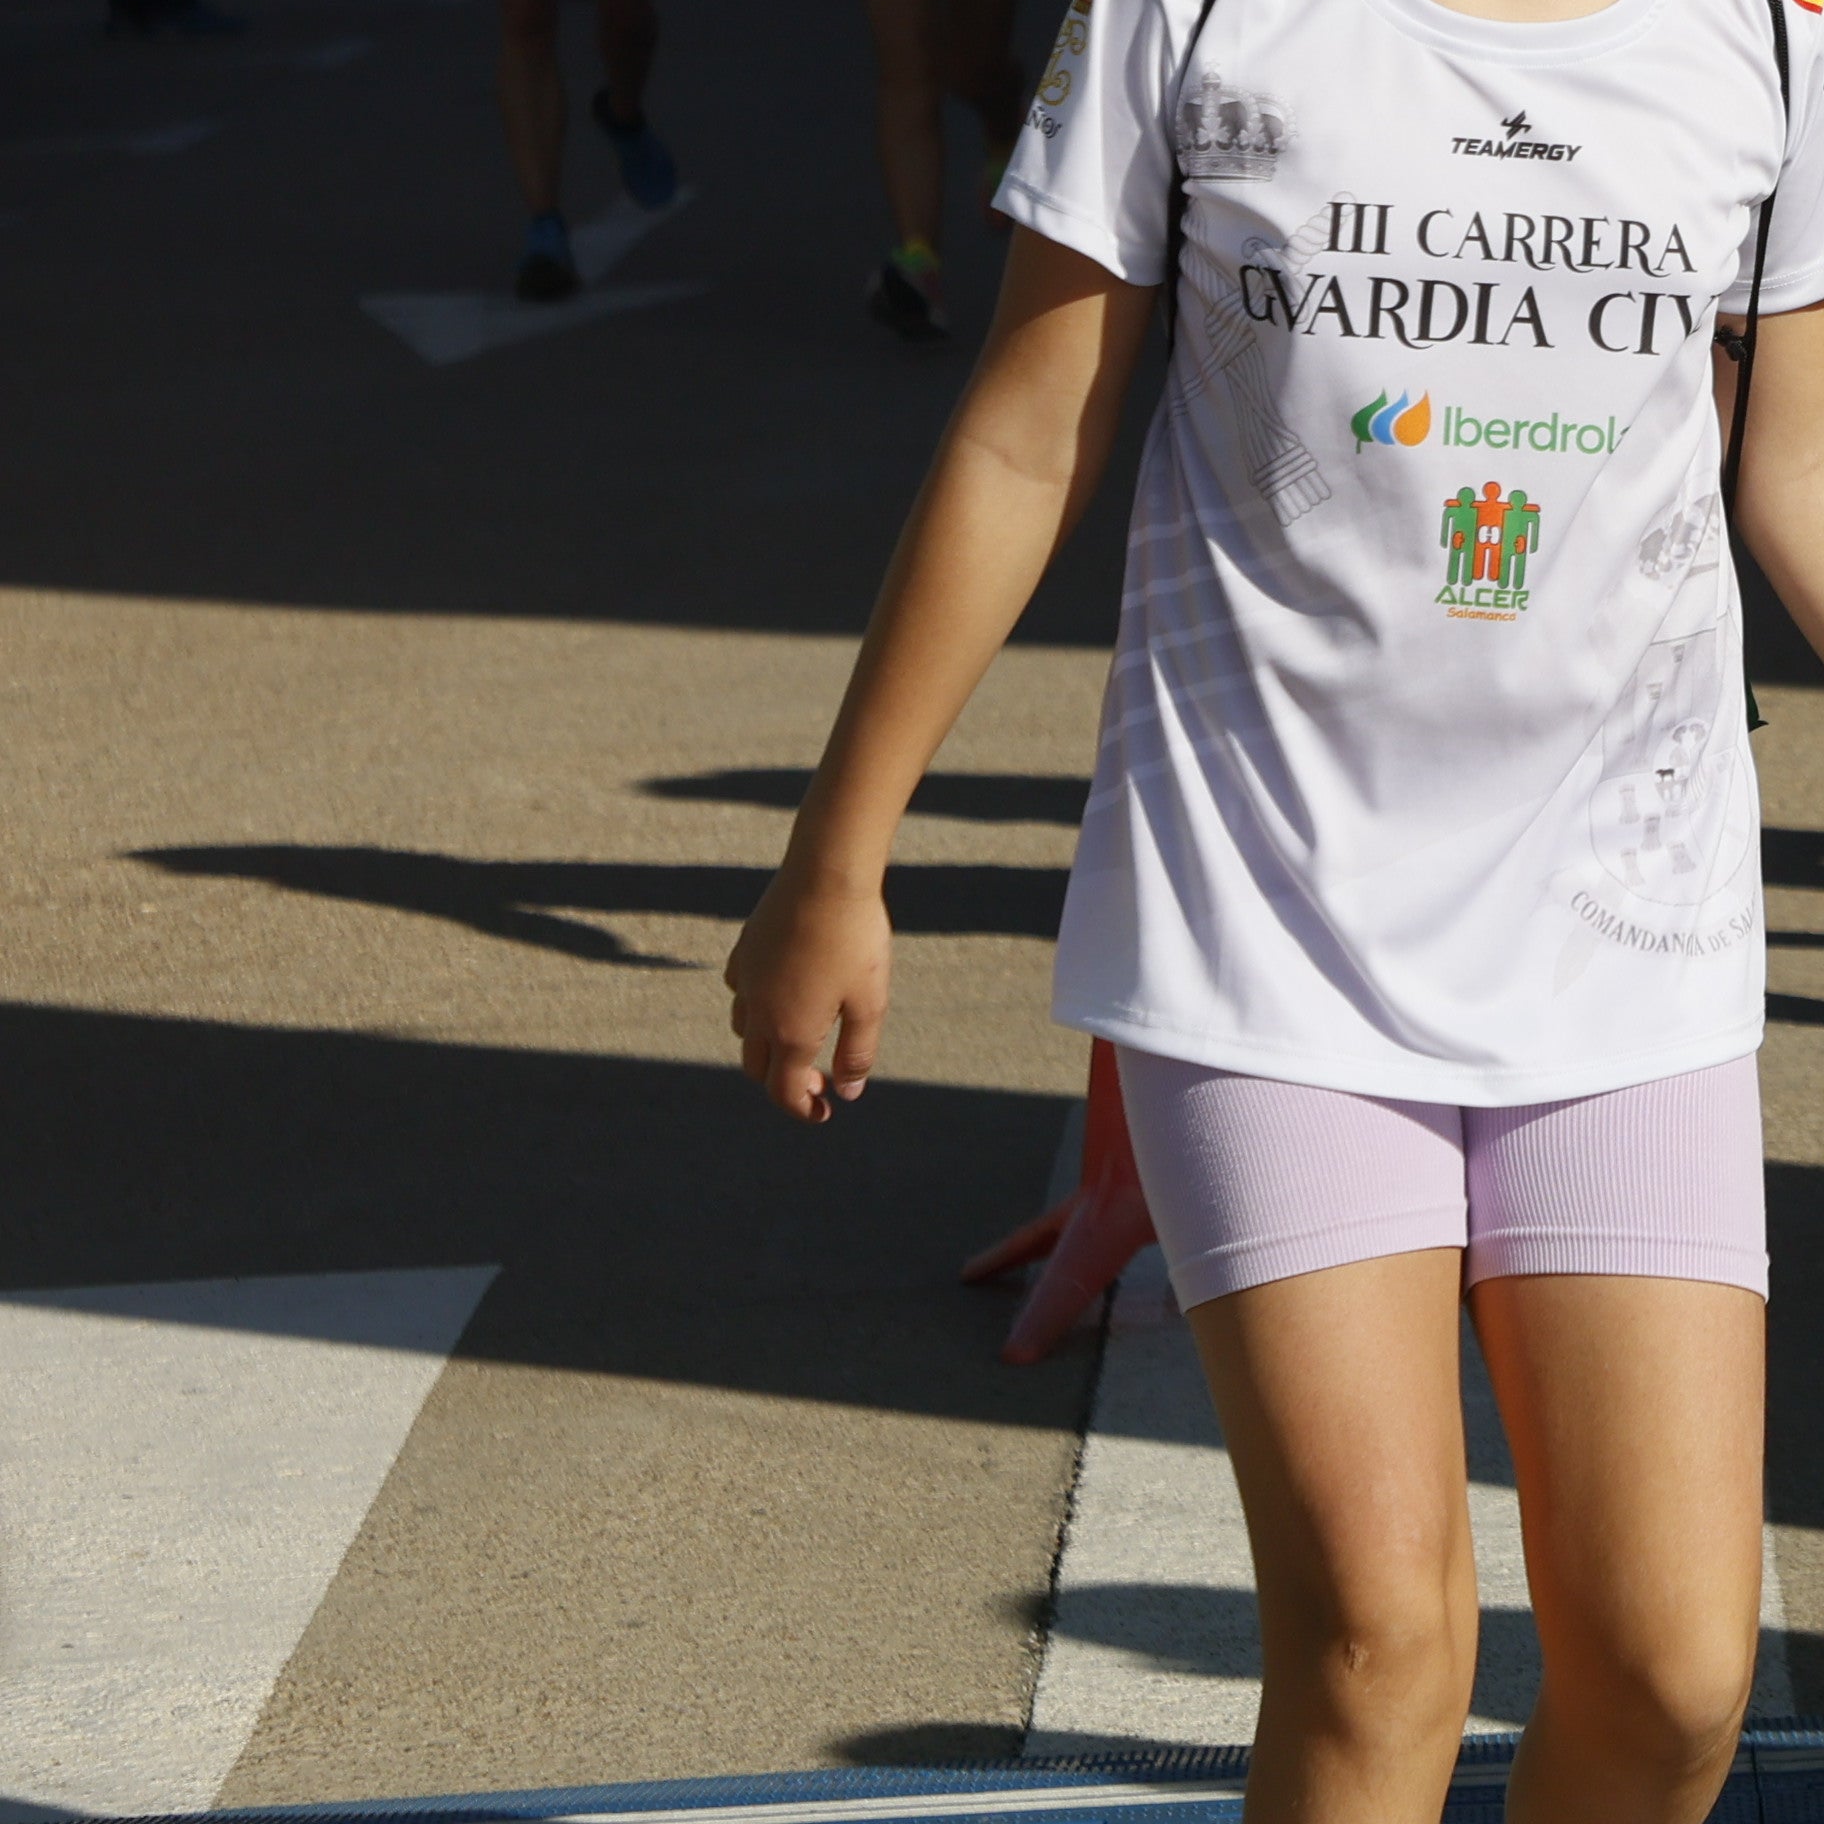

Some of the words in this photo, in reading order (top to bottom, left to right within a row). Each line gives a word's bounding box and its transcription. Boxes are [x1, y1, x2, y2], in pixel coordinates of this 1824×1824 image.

[1451, 138, 1582, 162] TEAMERGY
[1326, 201, 1394, 256] III
[1417, 208, 1697, 277] CARRERA
[1240, 264, 1554, 350] GVARDIA
[1588, 291, 1719, 356] CIV
[1434, 585, 1530, 611] ALCER
[1447, 607, 1516, 622] Salamanca
